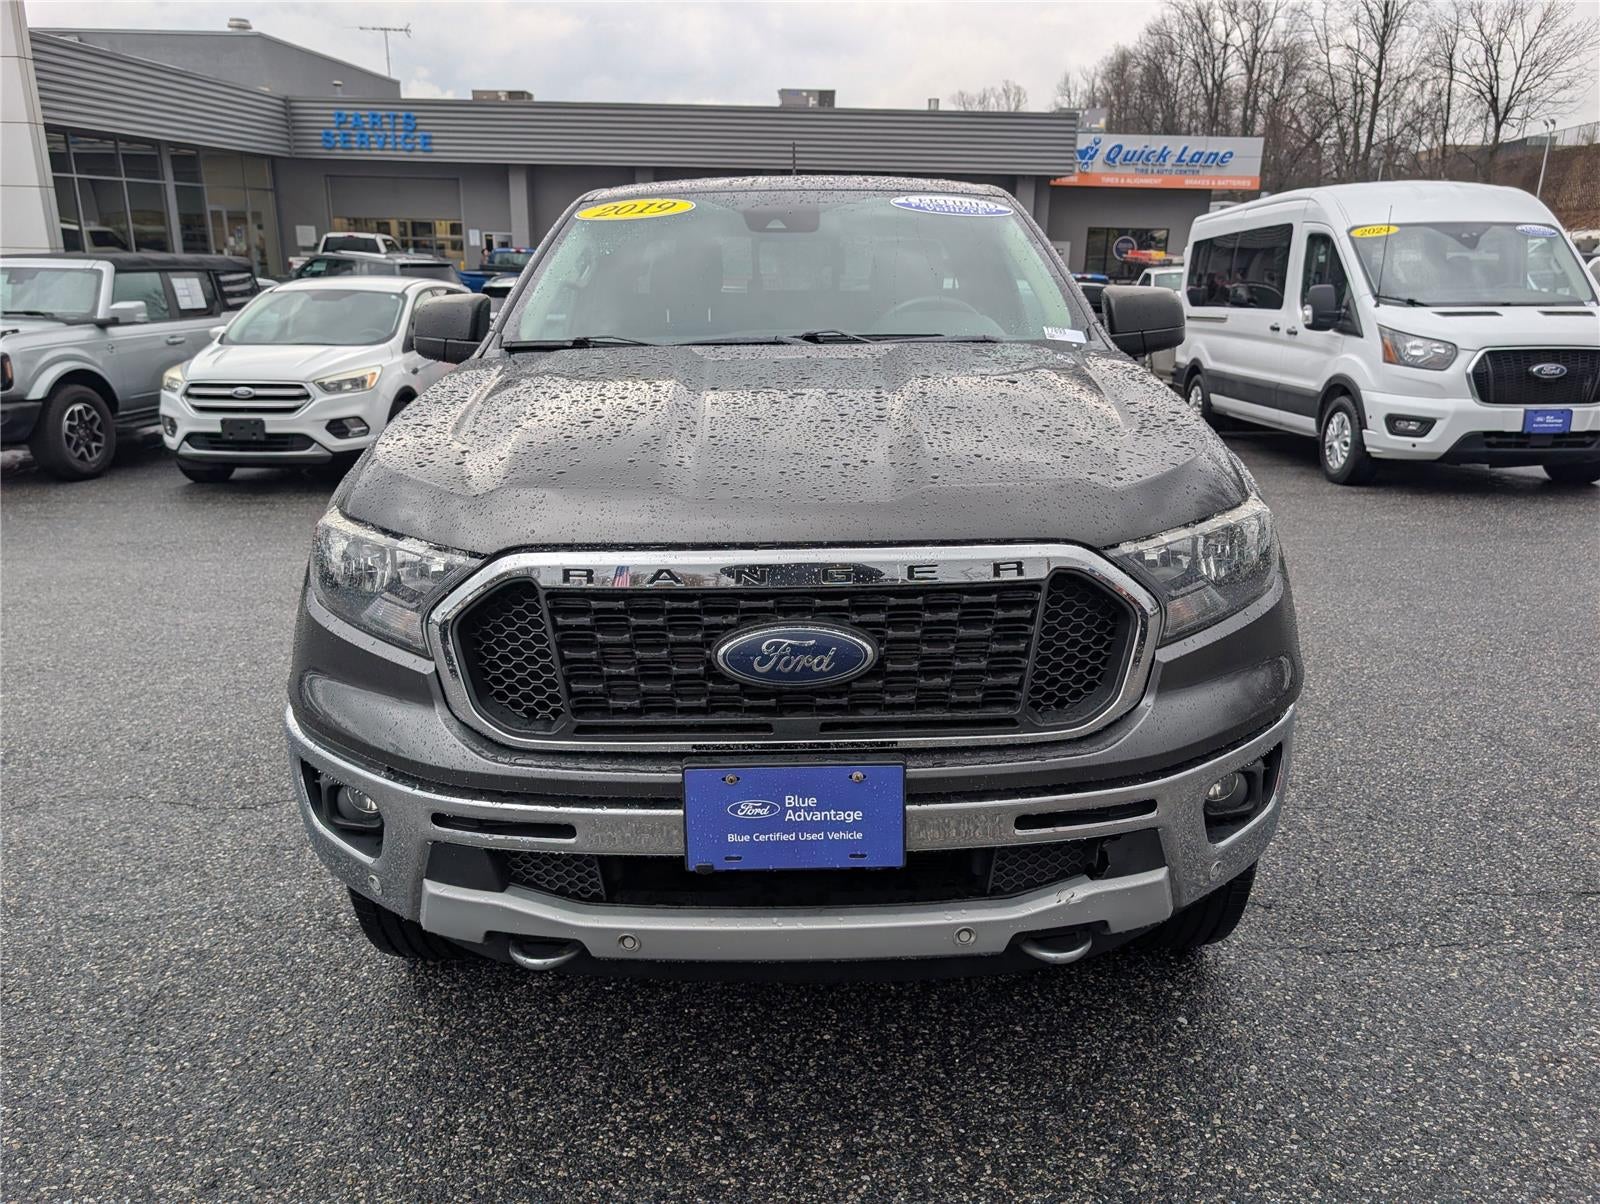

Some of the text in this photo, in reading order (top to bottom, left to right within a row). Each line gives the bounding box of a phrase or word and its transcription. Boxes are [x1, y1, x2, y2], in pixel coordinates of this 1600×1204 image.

[334, 111, 417, 131] PARTS
[322, 128, 433, 152] SERVICE
[1105, 143, 1234, 166] Quick Lane
[593, 201, 677, 218] 2019
[562, 560, 1025, 586] RANGER
[753, 638, 837, 673] Ford
[737, 802, 770, 816] Ford
[785, 795, 817, 808] Blue
[784, 809, 863, 823] Advantage
[727, 830, 863, 842] Blue Certified Used Vehicle
